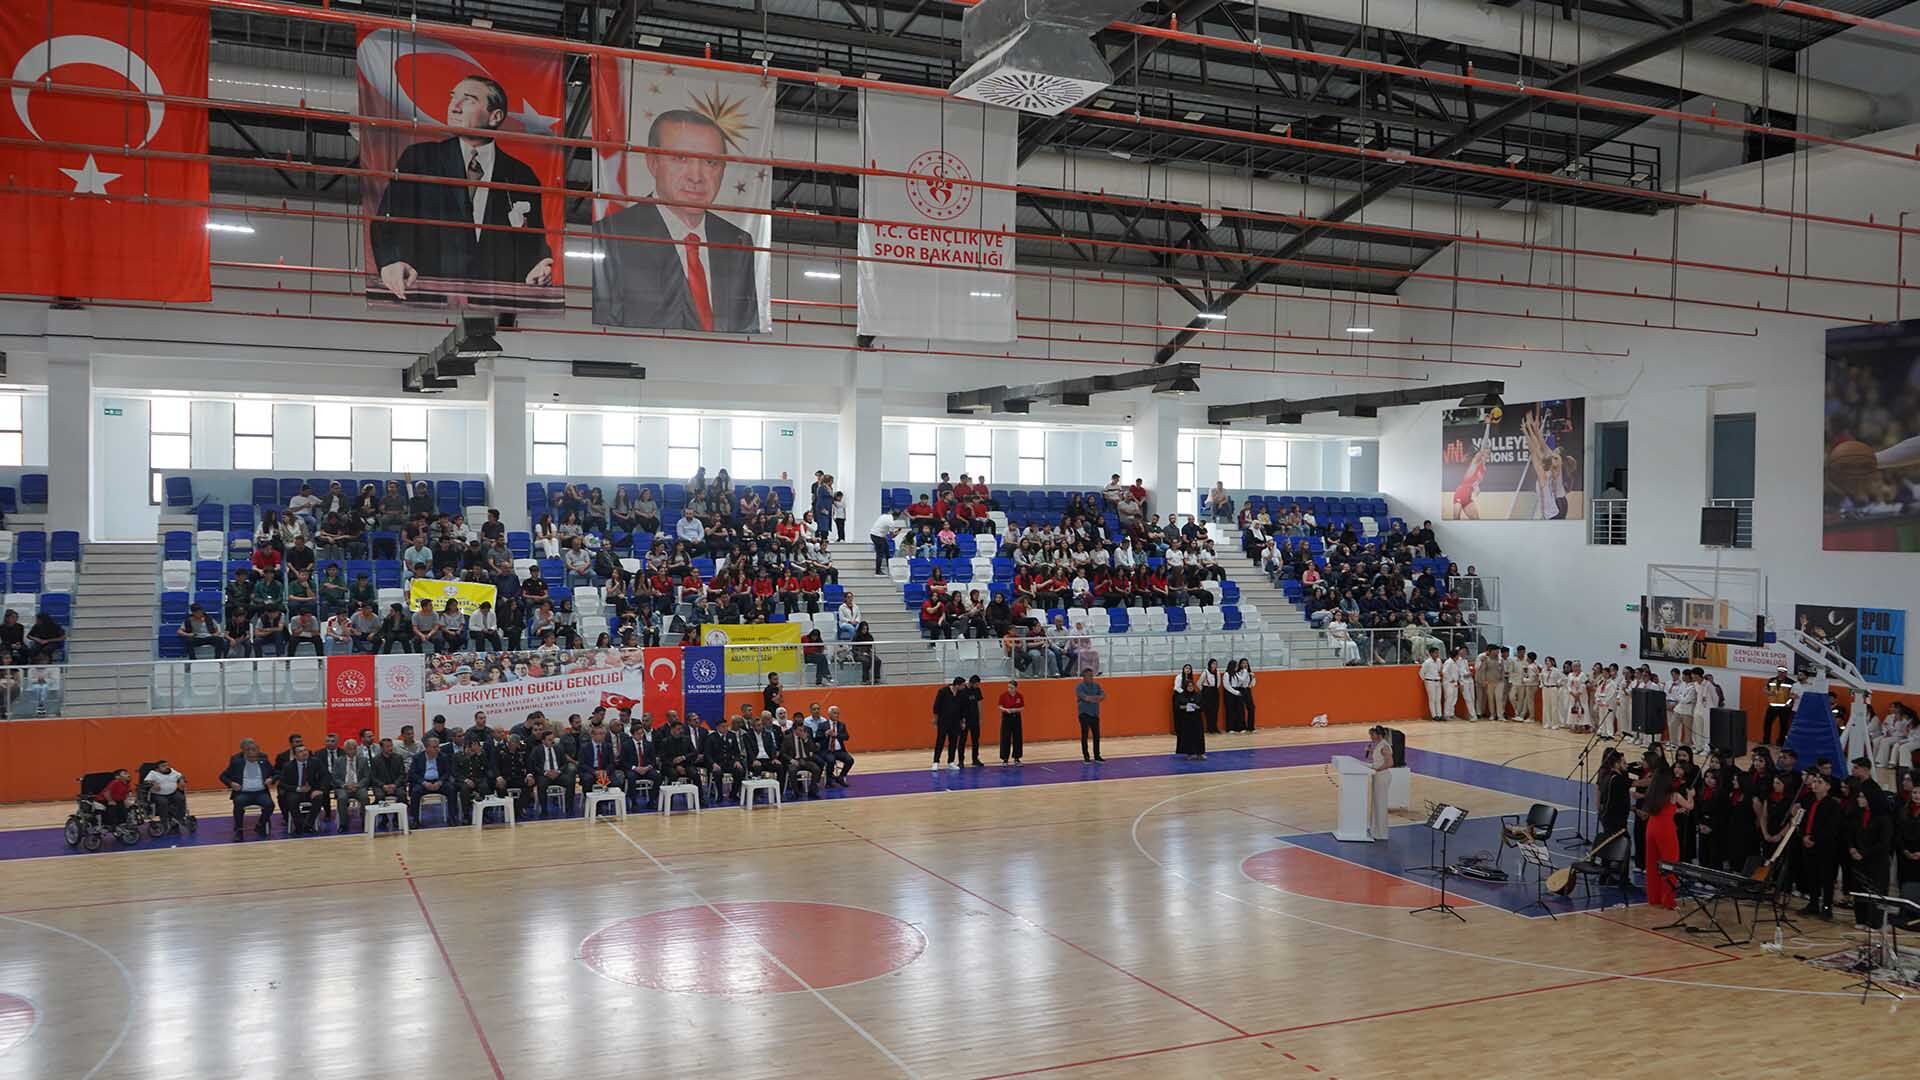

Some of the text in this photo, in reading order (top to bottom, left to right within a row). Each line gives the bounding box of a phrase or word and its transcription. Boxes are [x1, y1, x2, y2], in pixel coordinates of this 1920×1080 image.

[875, 224, 902, 239] T.C.
[984, 233, 1003, 247] VE
[874, 243, 1003, 266] SPOR BAKANLIĞI
